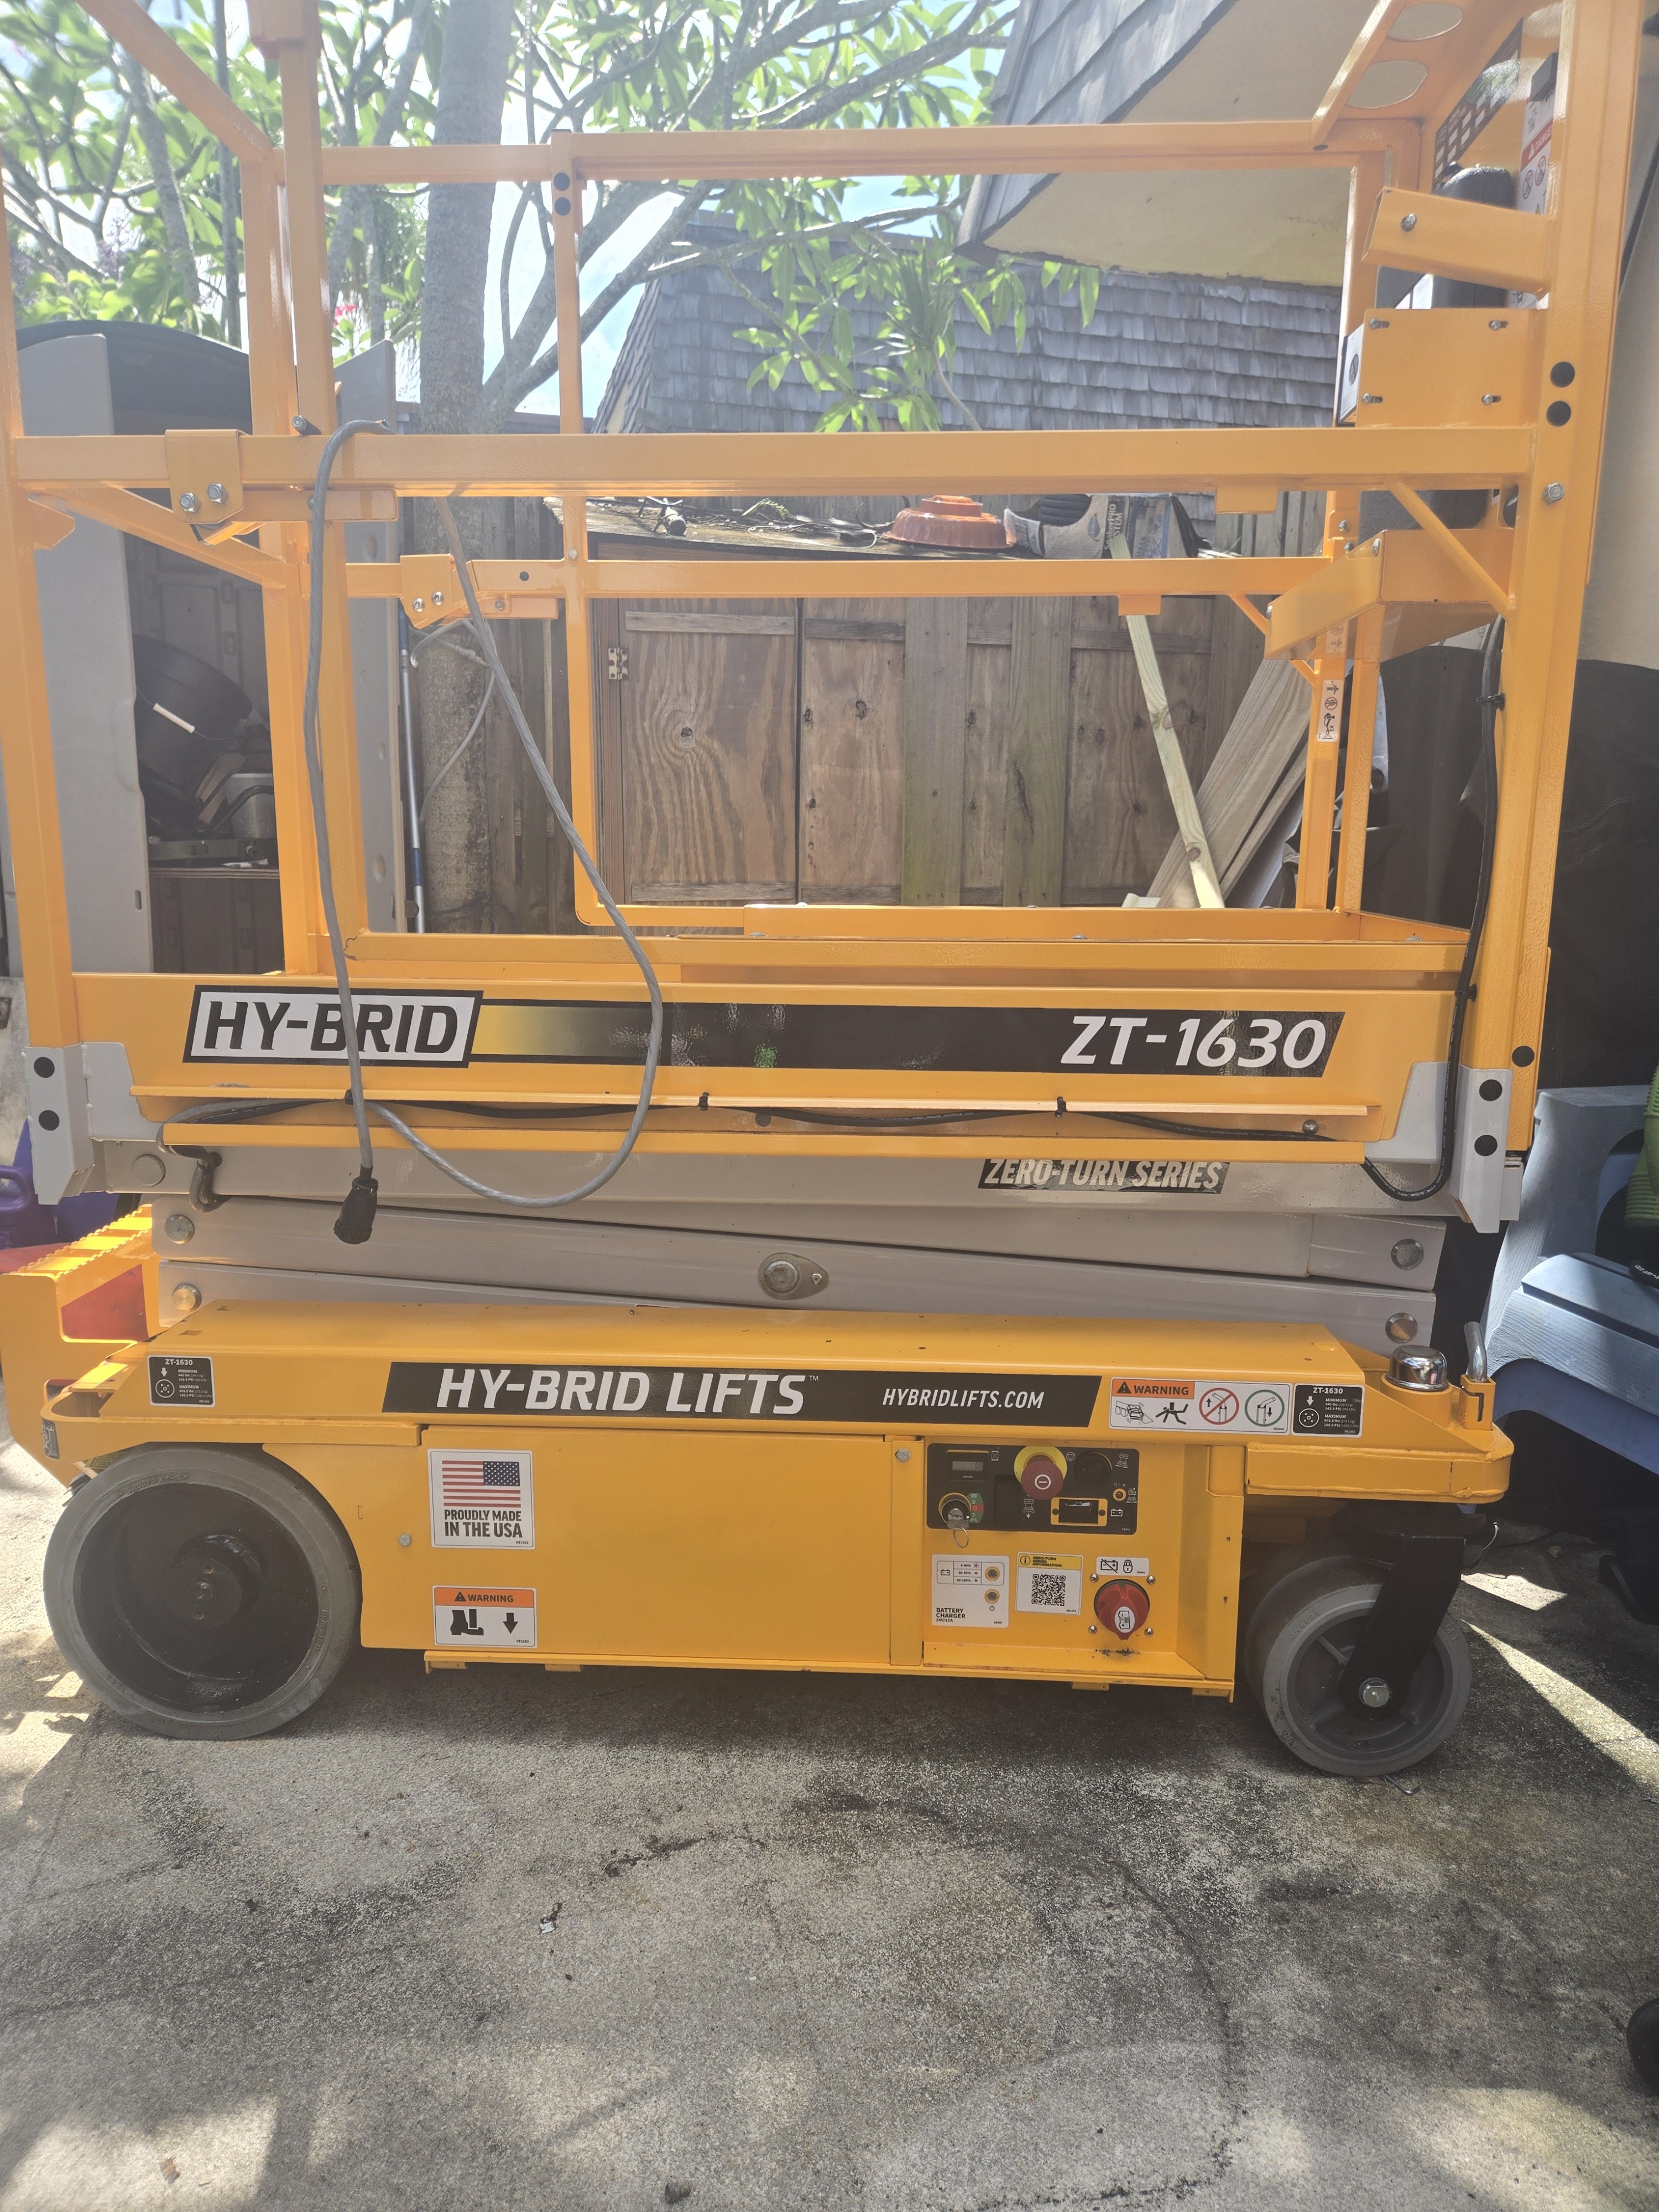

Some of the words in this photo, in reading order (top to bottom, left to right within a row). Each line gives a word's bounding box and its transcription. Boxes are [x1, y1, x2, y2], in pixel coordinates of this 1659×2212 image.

[204, 1000, 458, 1054] HY-BRID
[1060, 1016, 1326, 1068] ZT-1630
[984, 1159, 1124, 1188] ZERO-TURN
[1132, 1161, 1221, 1190] SERIES
[436, 1369, 648, 1412] HY-BRID
[882, 1388, 1045, 1409] HYBRIDLIFTS.COM
[1134, 1385, 1189, 1396] WARNING
[444, 1509, 490, 1521] PROUDLY
[492, 1510, 522, 1521] MADE
[445, 1521, 460, 1536] IN
[462, 1522, 491, 1537] THE
[493, 1522, 523, 1538] USA
[468, 1594, 514, 1603] WARNING
